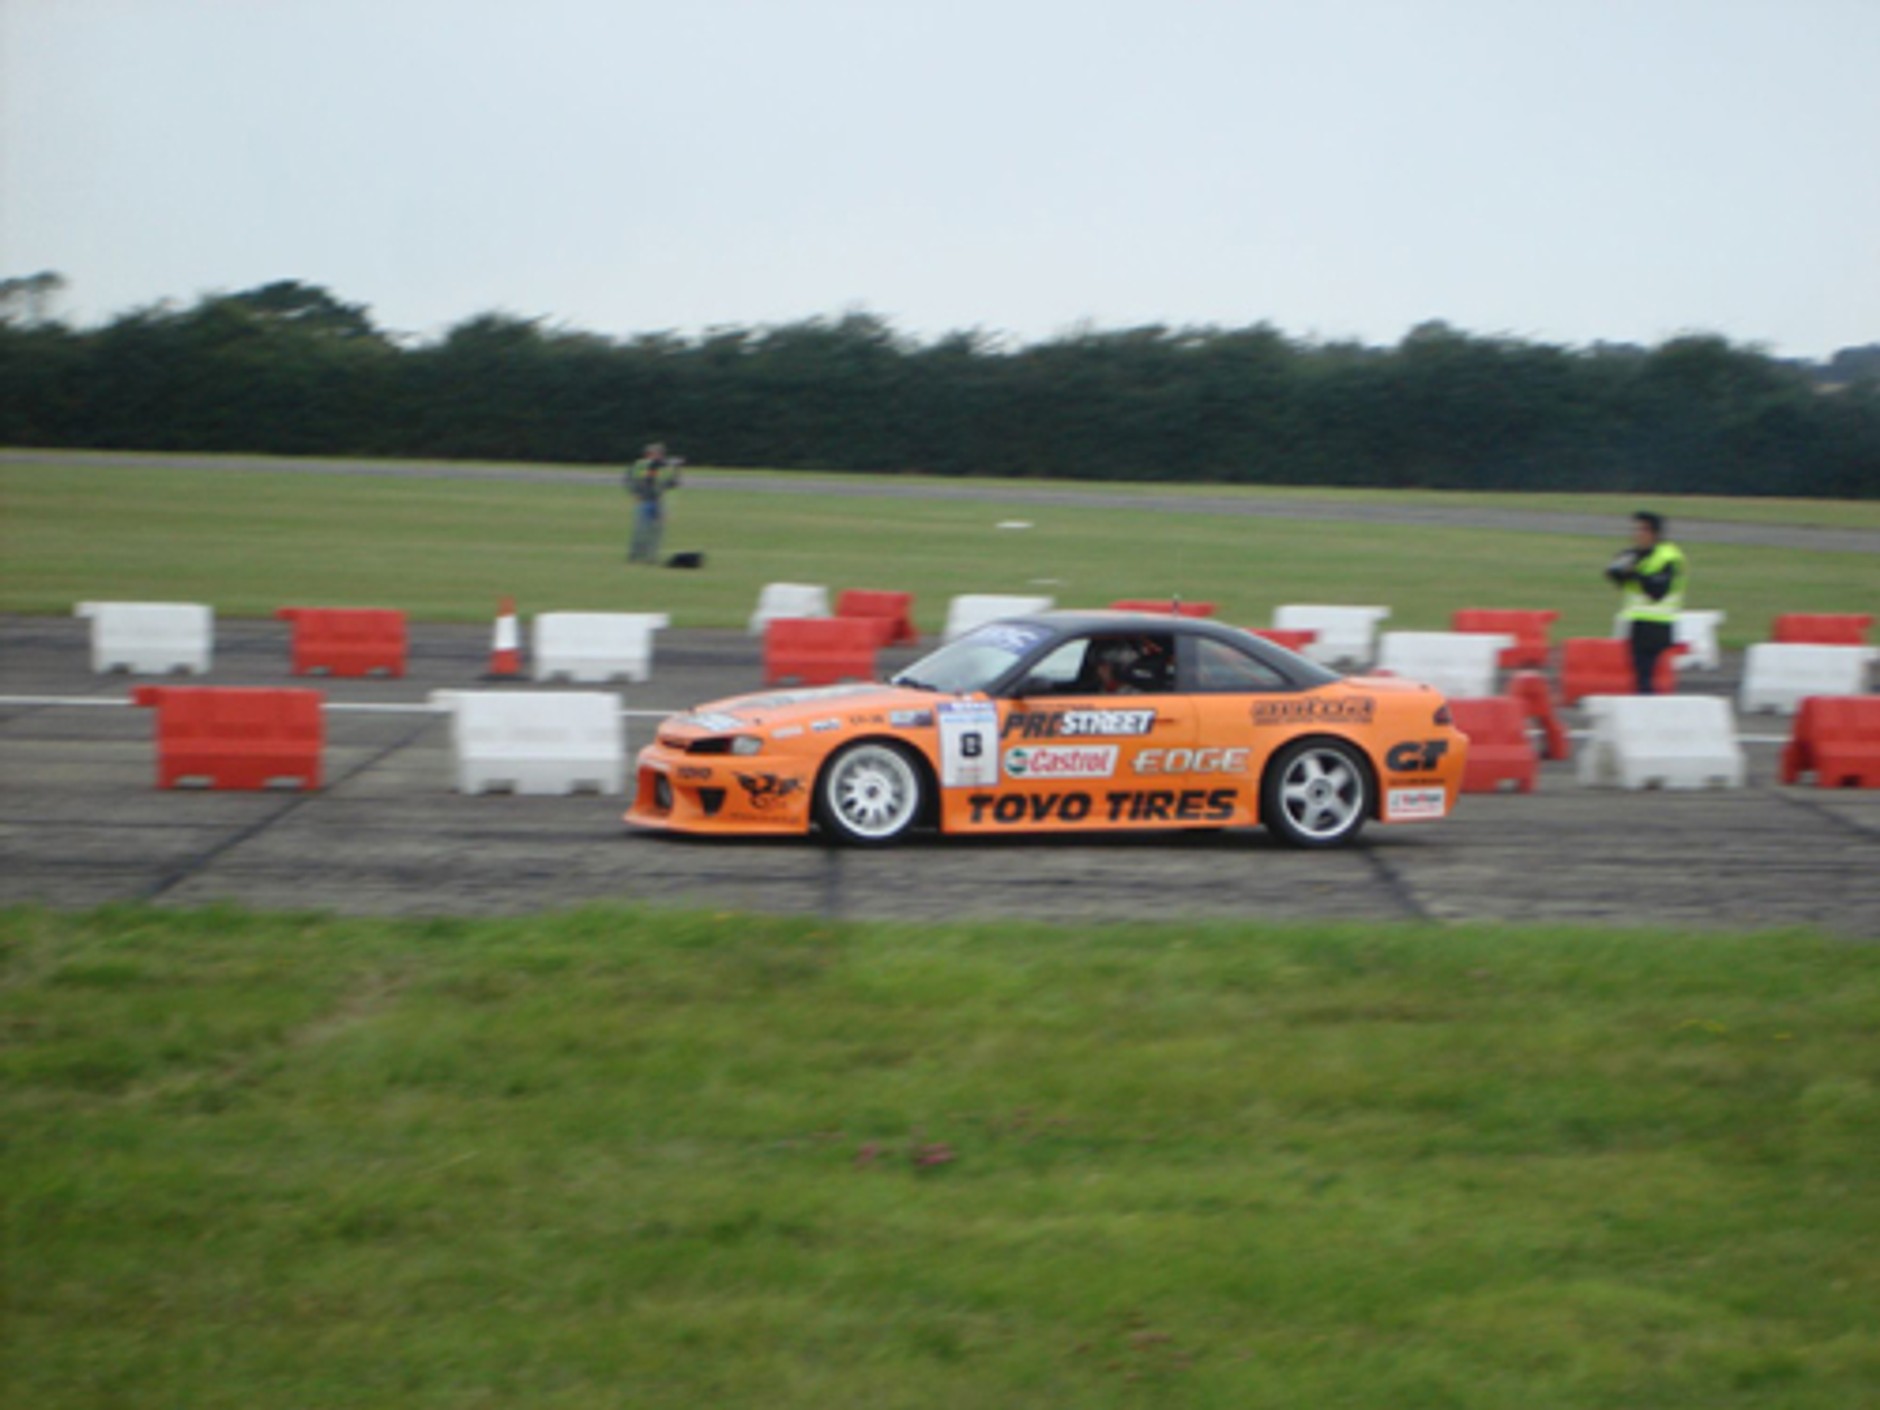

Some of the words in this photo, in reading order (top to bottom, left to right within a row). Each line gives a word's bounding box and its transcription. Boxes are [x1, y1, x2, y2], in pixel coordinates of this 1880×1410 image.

[1028, 748, 1111, 773] Castrol
[1132, 748, 1250, 774] EDGE
[1385, 740, 1449, 772] GT
[1105, 788, 1238, 822] TIRES
